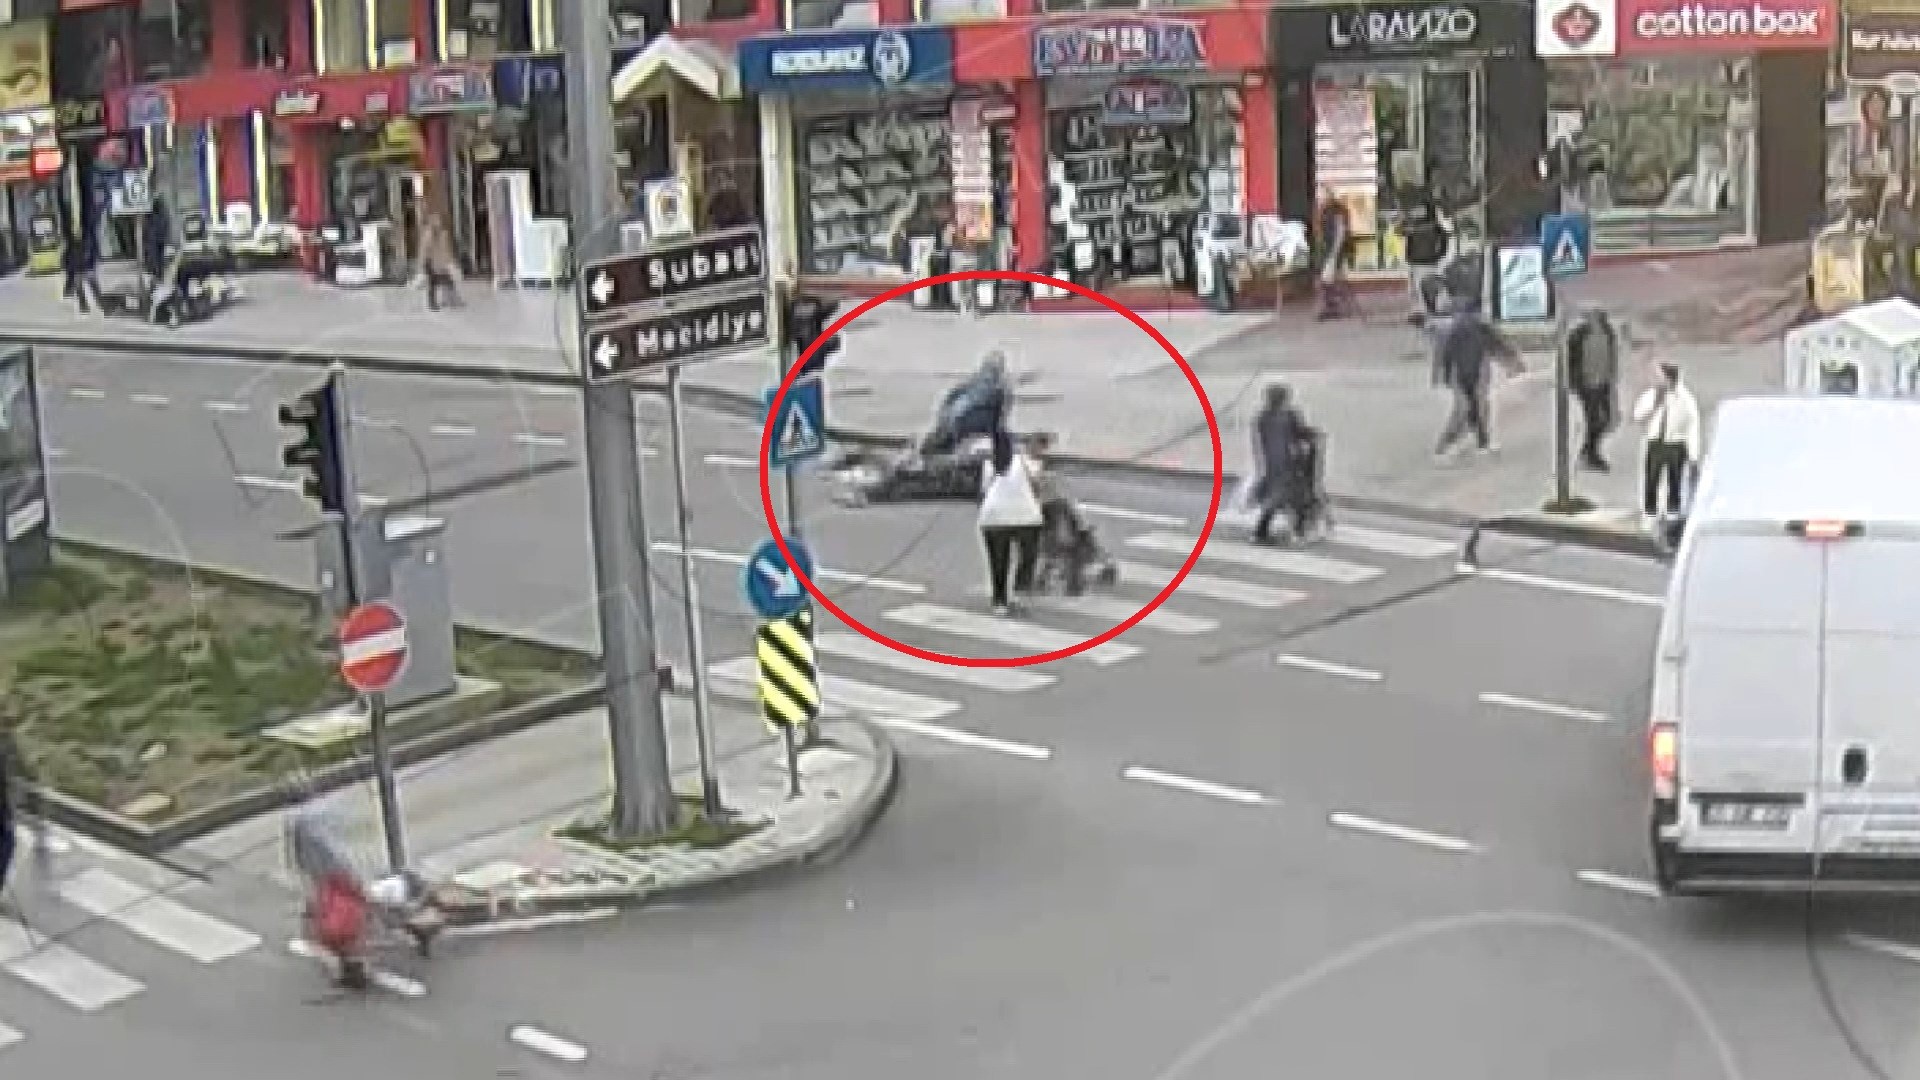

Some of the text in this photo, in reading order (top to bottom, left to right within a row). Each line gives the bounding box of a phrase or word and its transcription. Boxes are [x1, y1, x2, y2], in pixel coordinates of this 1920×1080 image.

[1330, 8, 1477, 47] LARANZO
[1636, 2, 1818, 37] cotton box
